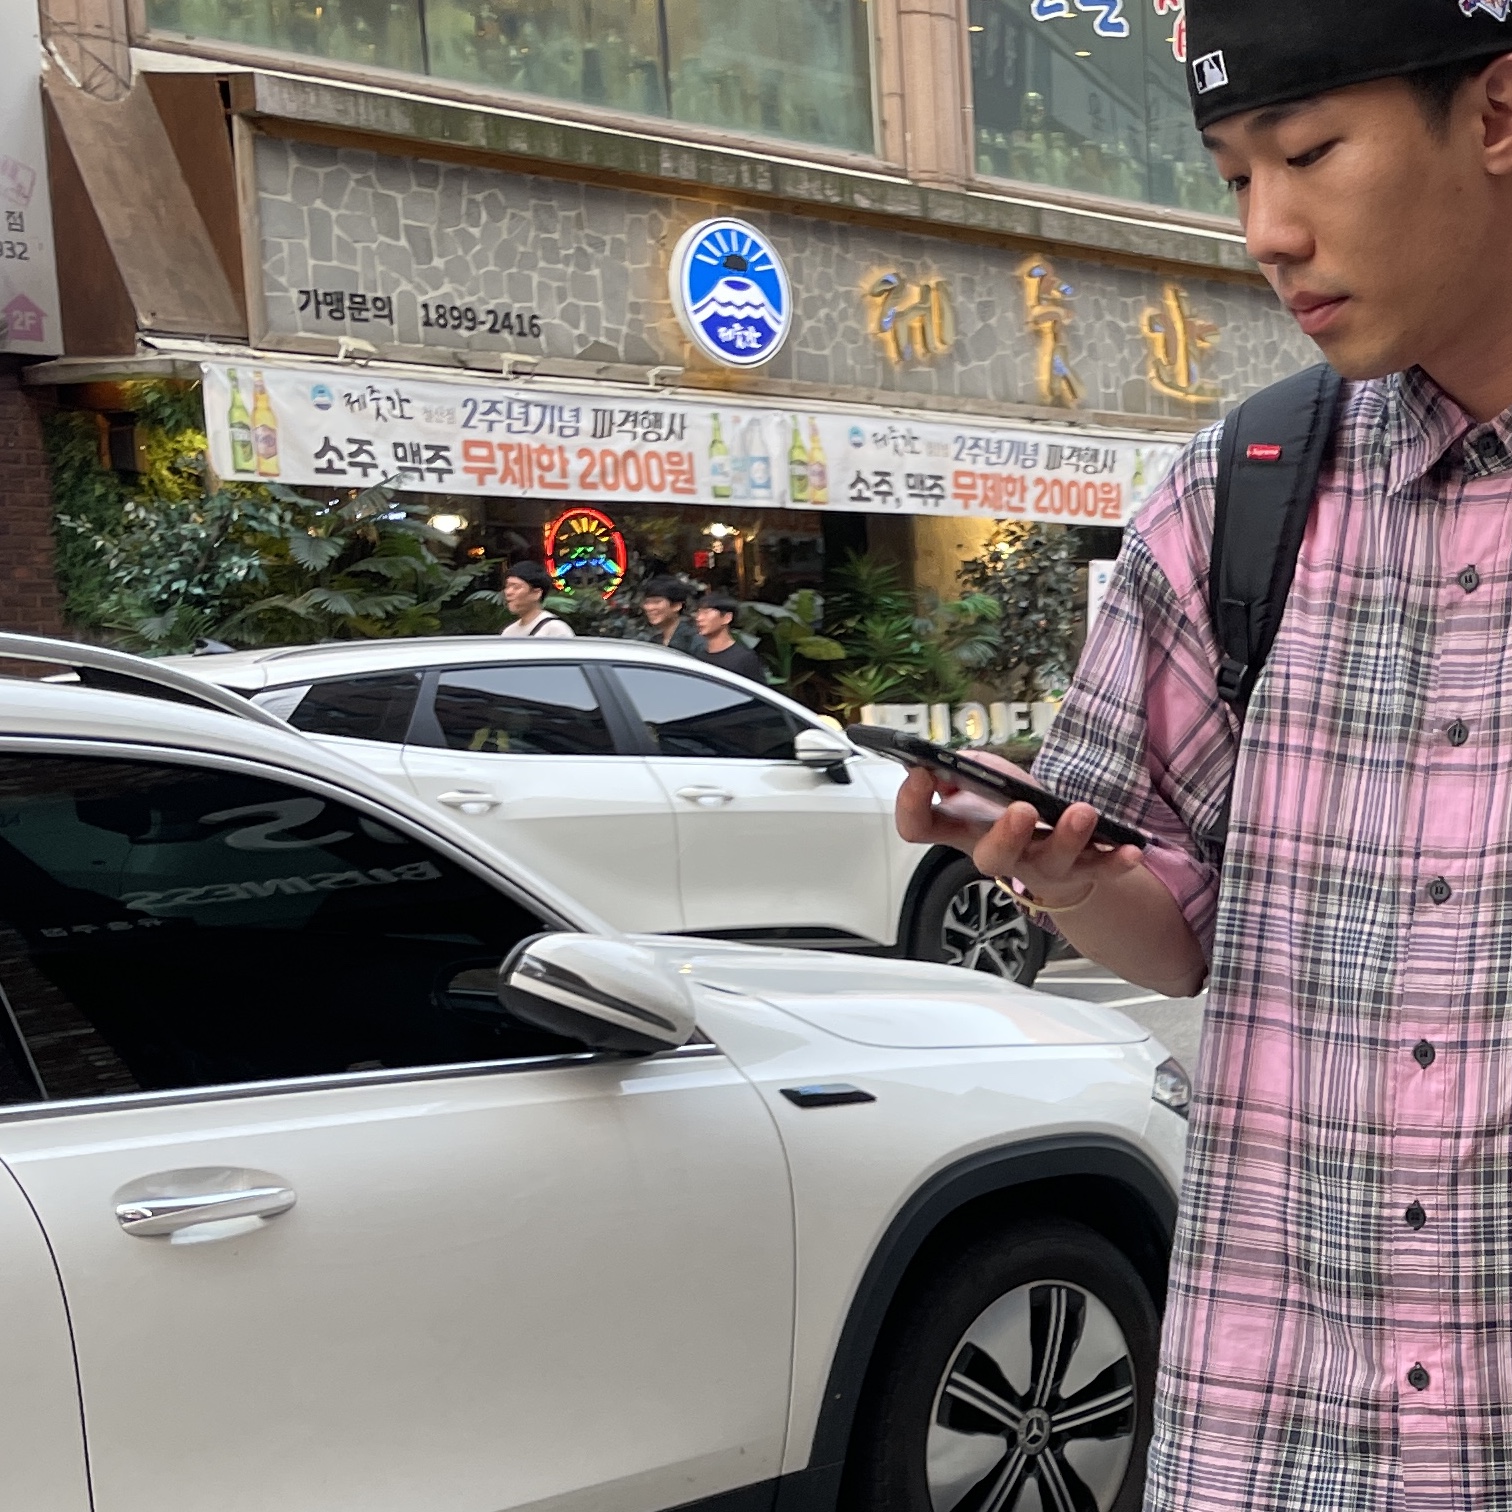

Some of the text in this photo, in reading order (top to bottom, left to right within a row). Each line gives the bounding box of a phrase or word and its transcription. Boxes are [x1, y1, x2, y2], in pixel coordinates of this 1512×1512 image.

[12, 310, 37, 331] 2F
[298, 289, 542, 339] 가맹문의 1899-2416
[461, 397, 582, 438] 2주년기념
[589, 407, 688, 443] 파격행사
[314, 436, 697, 495] 소주, 맥주 무제한 2000원
[952, 434, 1040, 470] 2주년기념
[849, 469, 900, 510] 소주,
[951, 470, 1028, 514] 무제한
[1032, 476, 1123, 520] 2000원
